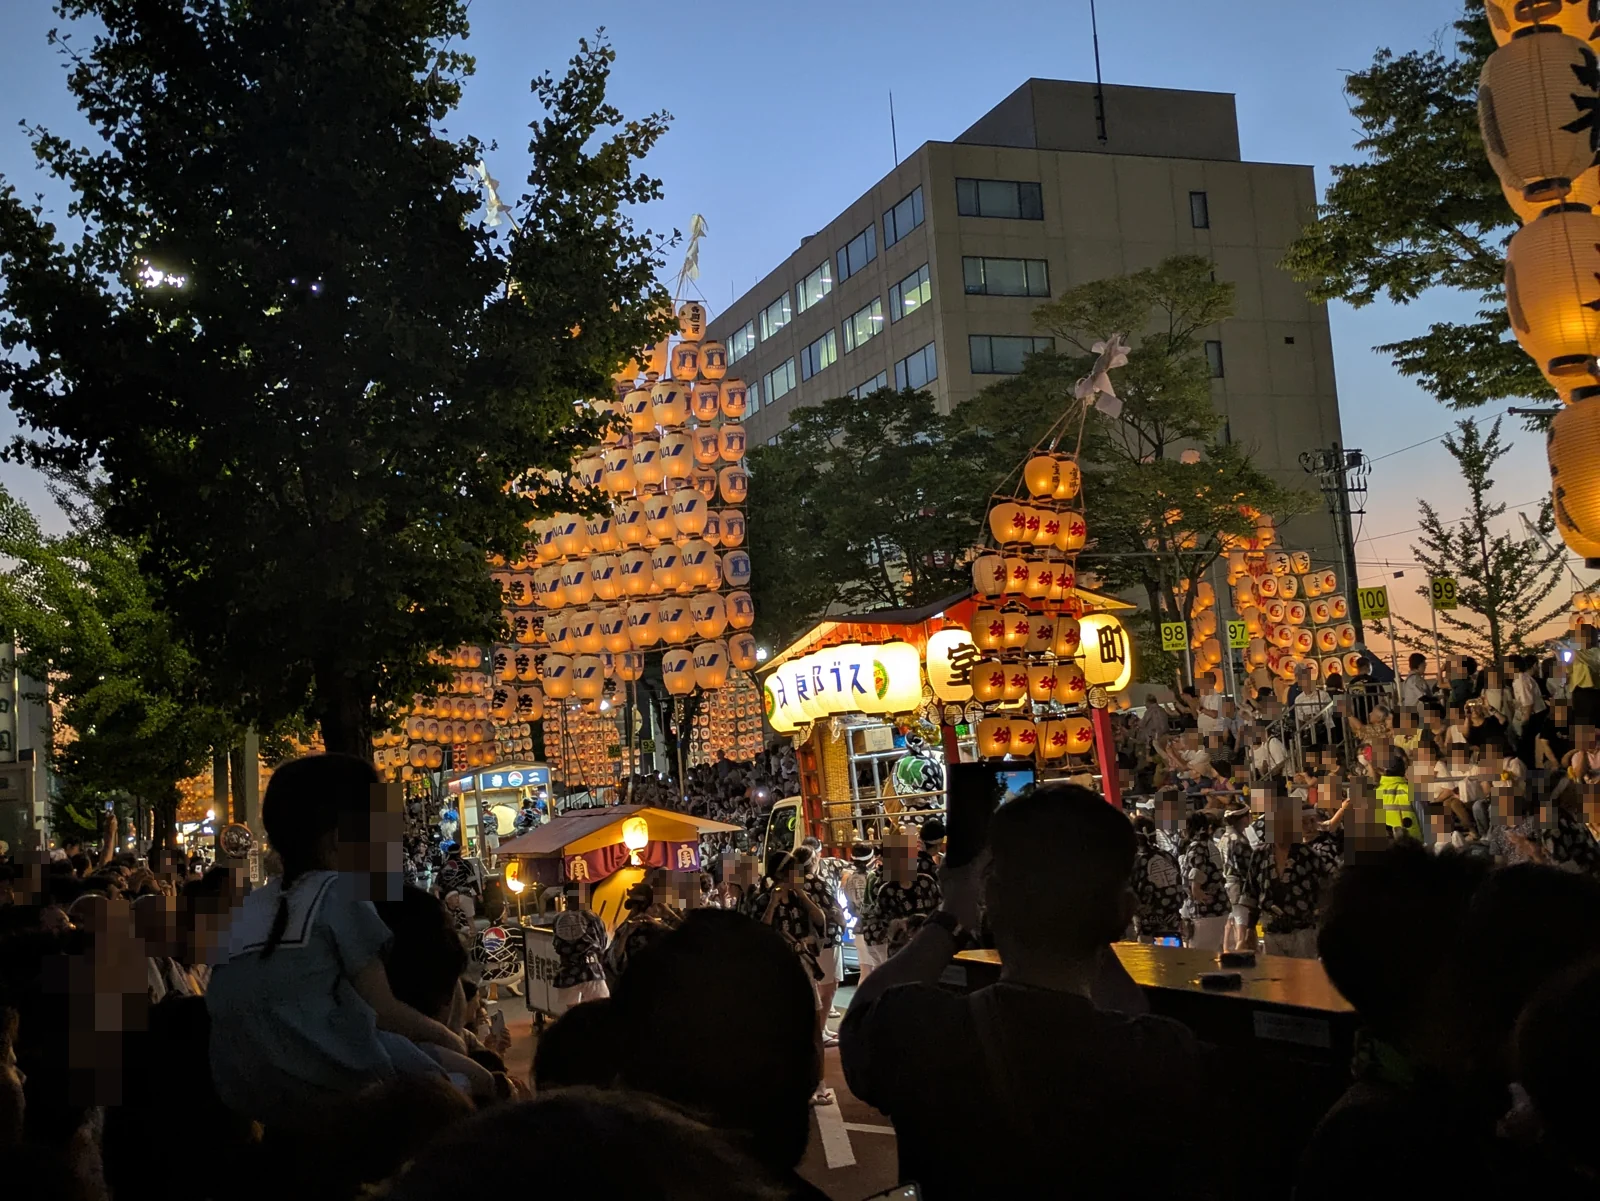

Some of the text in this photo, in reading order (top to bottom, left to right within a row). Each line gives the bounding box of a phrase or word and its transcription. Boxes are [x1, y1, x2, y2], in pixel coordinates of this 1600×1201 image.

[1360, 590, 1385, 609] 100
[1432, 581, 1455, 600] 99
[1163, 625, 1185, 642] 98
[1228, 624, 1246, 639] 97
[1097, 625, 1125, 665] 町
[643, 741, 655, 749] 93
